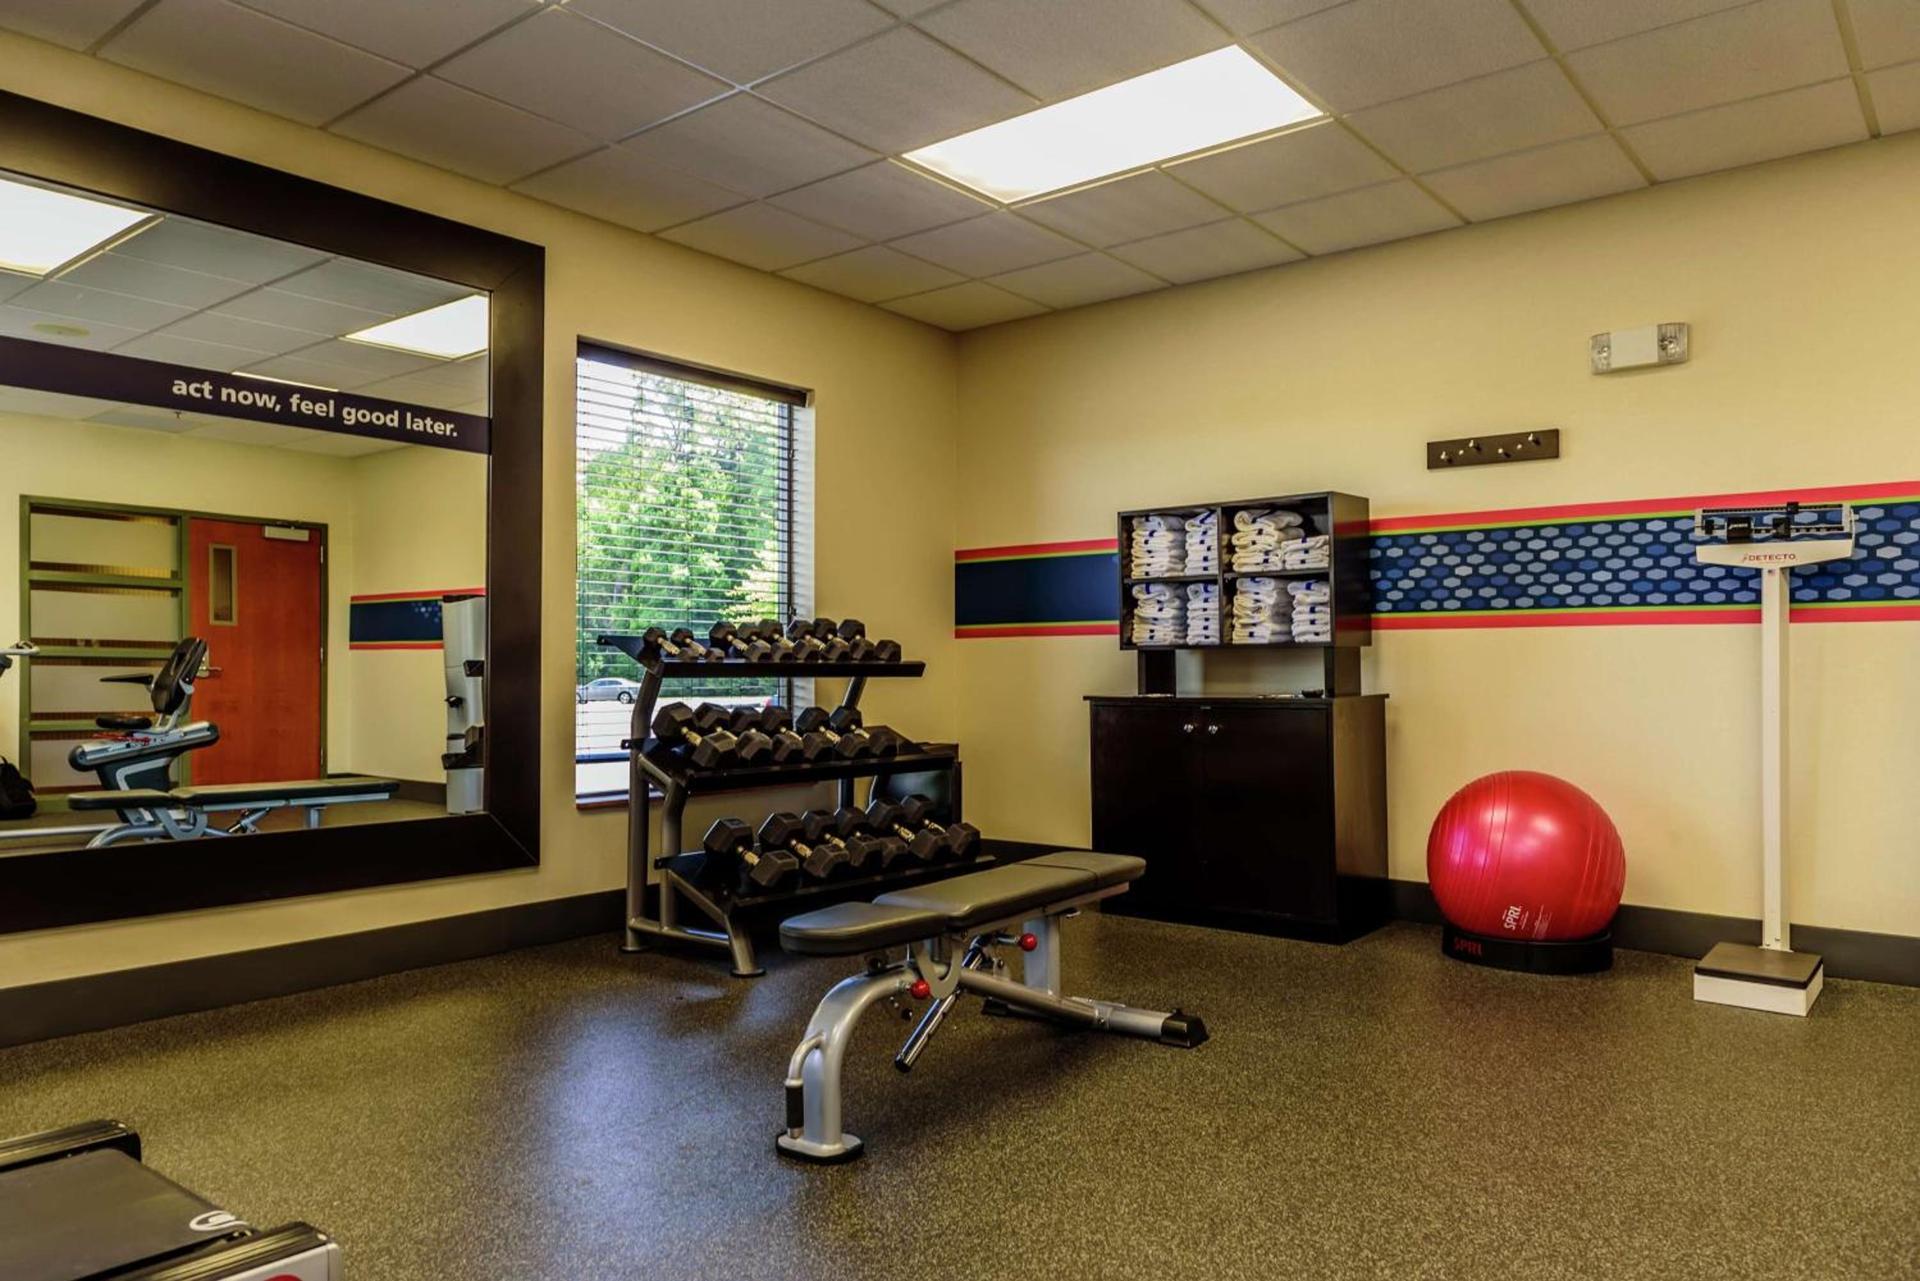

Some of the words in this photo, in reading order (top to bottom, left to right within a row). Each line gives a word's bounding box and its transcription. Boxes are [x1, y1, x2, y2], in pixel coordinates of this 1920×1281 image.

[172, 379, 213, 400] act
[220, 386, 281, 412] now,
[289, 394, 335, 418] feel
[342, 406, 399, 427] good
[406, 412, 459, 437] later.
[1747, 553, 1796, 561] DETECTO
[1504, 906, 1521, 930] SPRI
